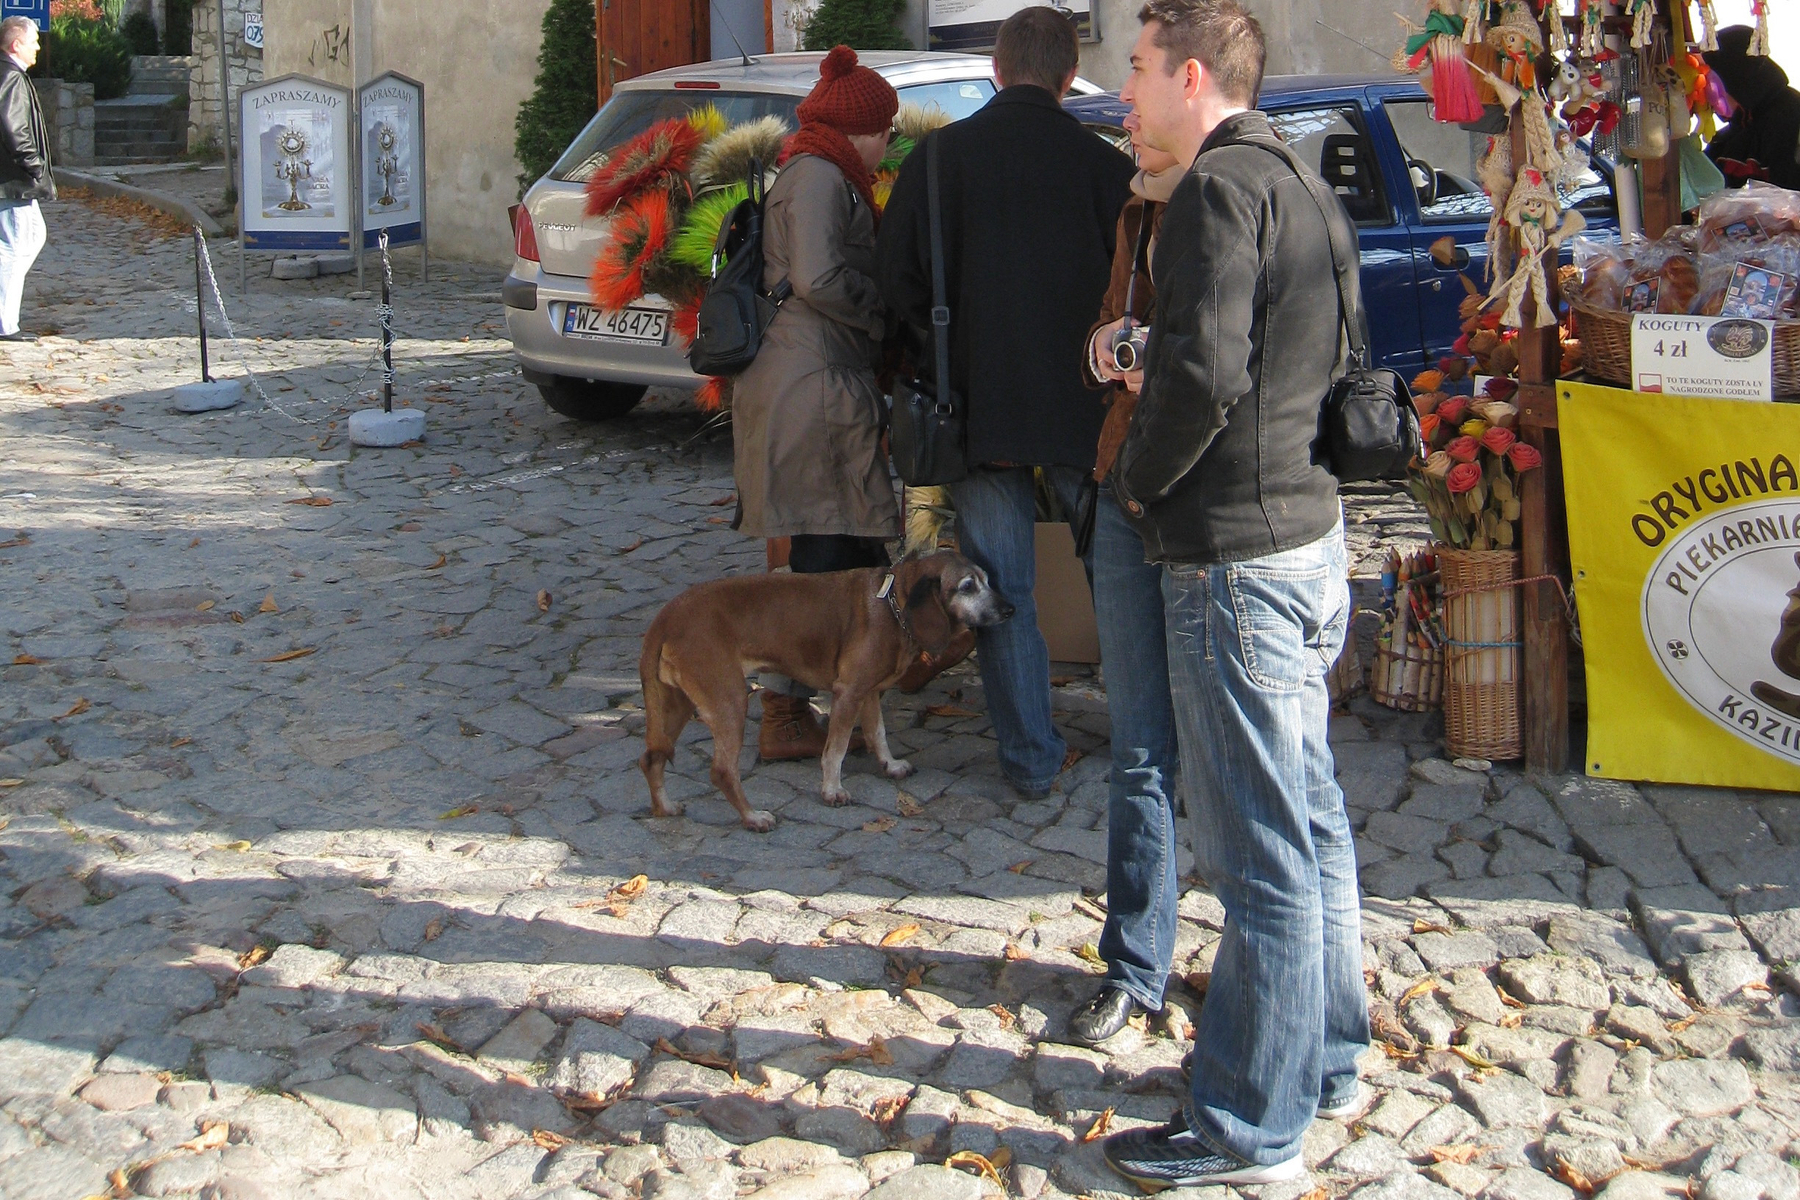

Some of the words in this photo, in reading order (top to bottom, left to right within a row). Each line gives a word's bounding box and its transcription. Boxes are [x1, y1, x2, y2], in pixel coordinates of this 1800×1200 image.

[252, 90, 342, 110] ZAPRASZAMY
[362, 87, 414, 109] ZAPRASZAMY
[538, 222, 576, 231] PEUGEOT
[576, 307, 603, 332] WZ
[606, 311, 664, 337] 46475
[1638, 319, 1705, 332] KOGUTY
[1653, 339, 1665, 357] 4
[1670, 339, 1688, 357] zł
[1670, 386, 1724, 395] NAGRODZONE
[1725, 387, 1760, 396] GODŁEM
[1679, 377, 1690, 385] TE
[1690, 377, 1723, 387] KOGUTY
[1630, 453, 1798, 548] ORYGINA
